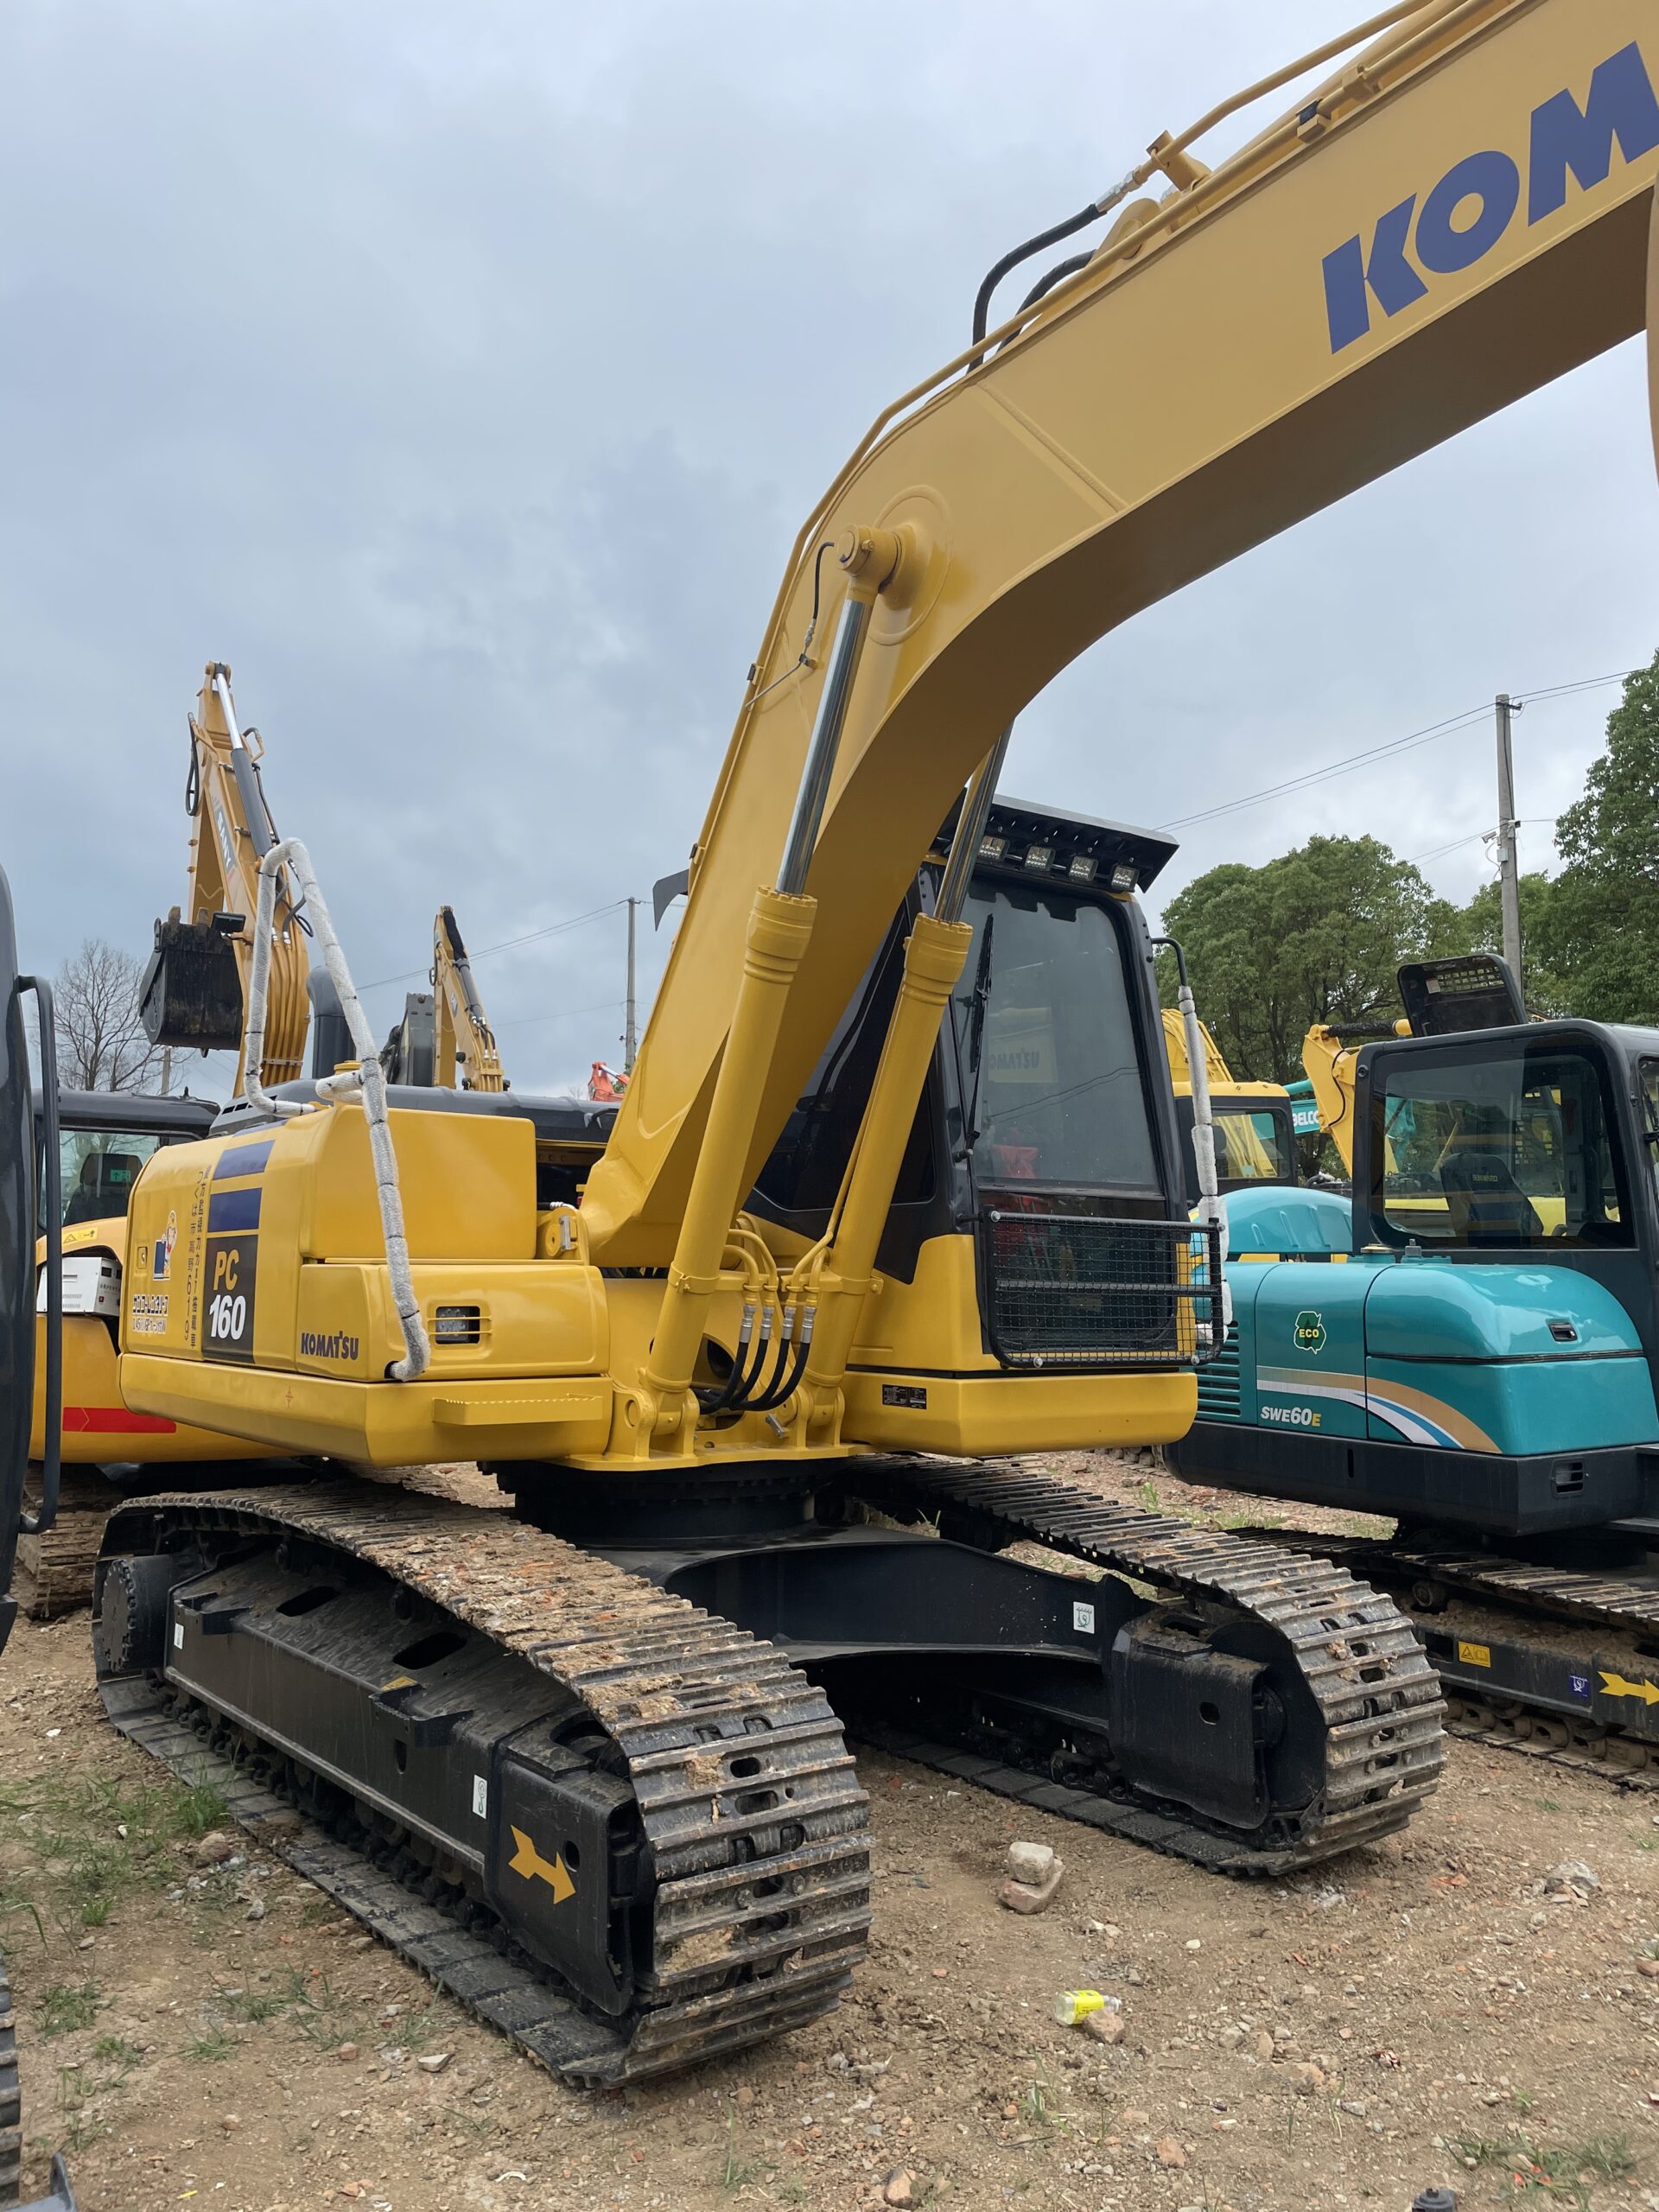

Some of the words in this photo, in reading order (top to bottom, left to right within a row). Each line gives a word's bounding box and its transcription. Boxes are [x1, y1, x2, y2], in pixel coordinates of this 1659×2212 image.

[1322, 40, 1659, 355] KOM
[218, 811, 231, 868] SANY
[213, 1249, 239, 1291] PC
[209, 1294, 246, 1340] 160
[1299, 1328, 1319, 1338] ECO
[301, 1331, 359, 1361] KOMATSU
[1260, 1406, 1321, 1427] SWE60E
